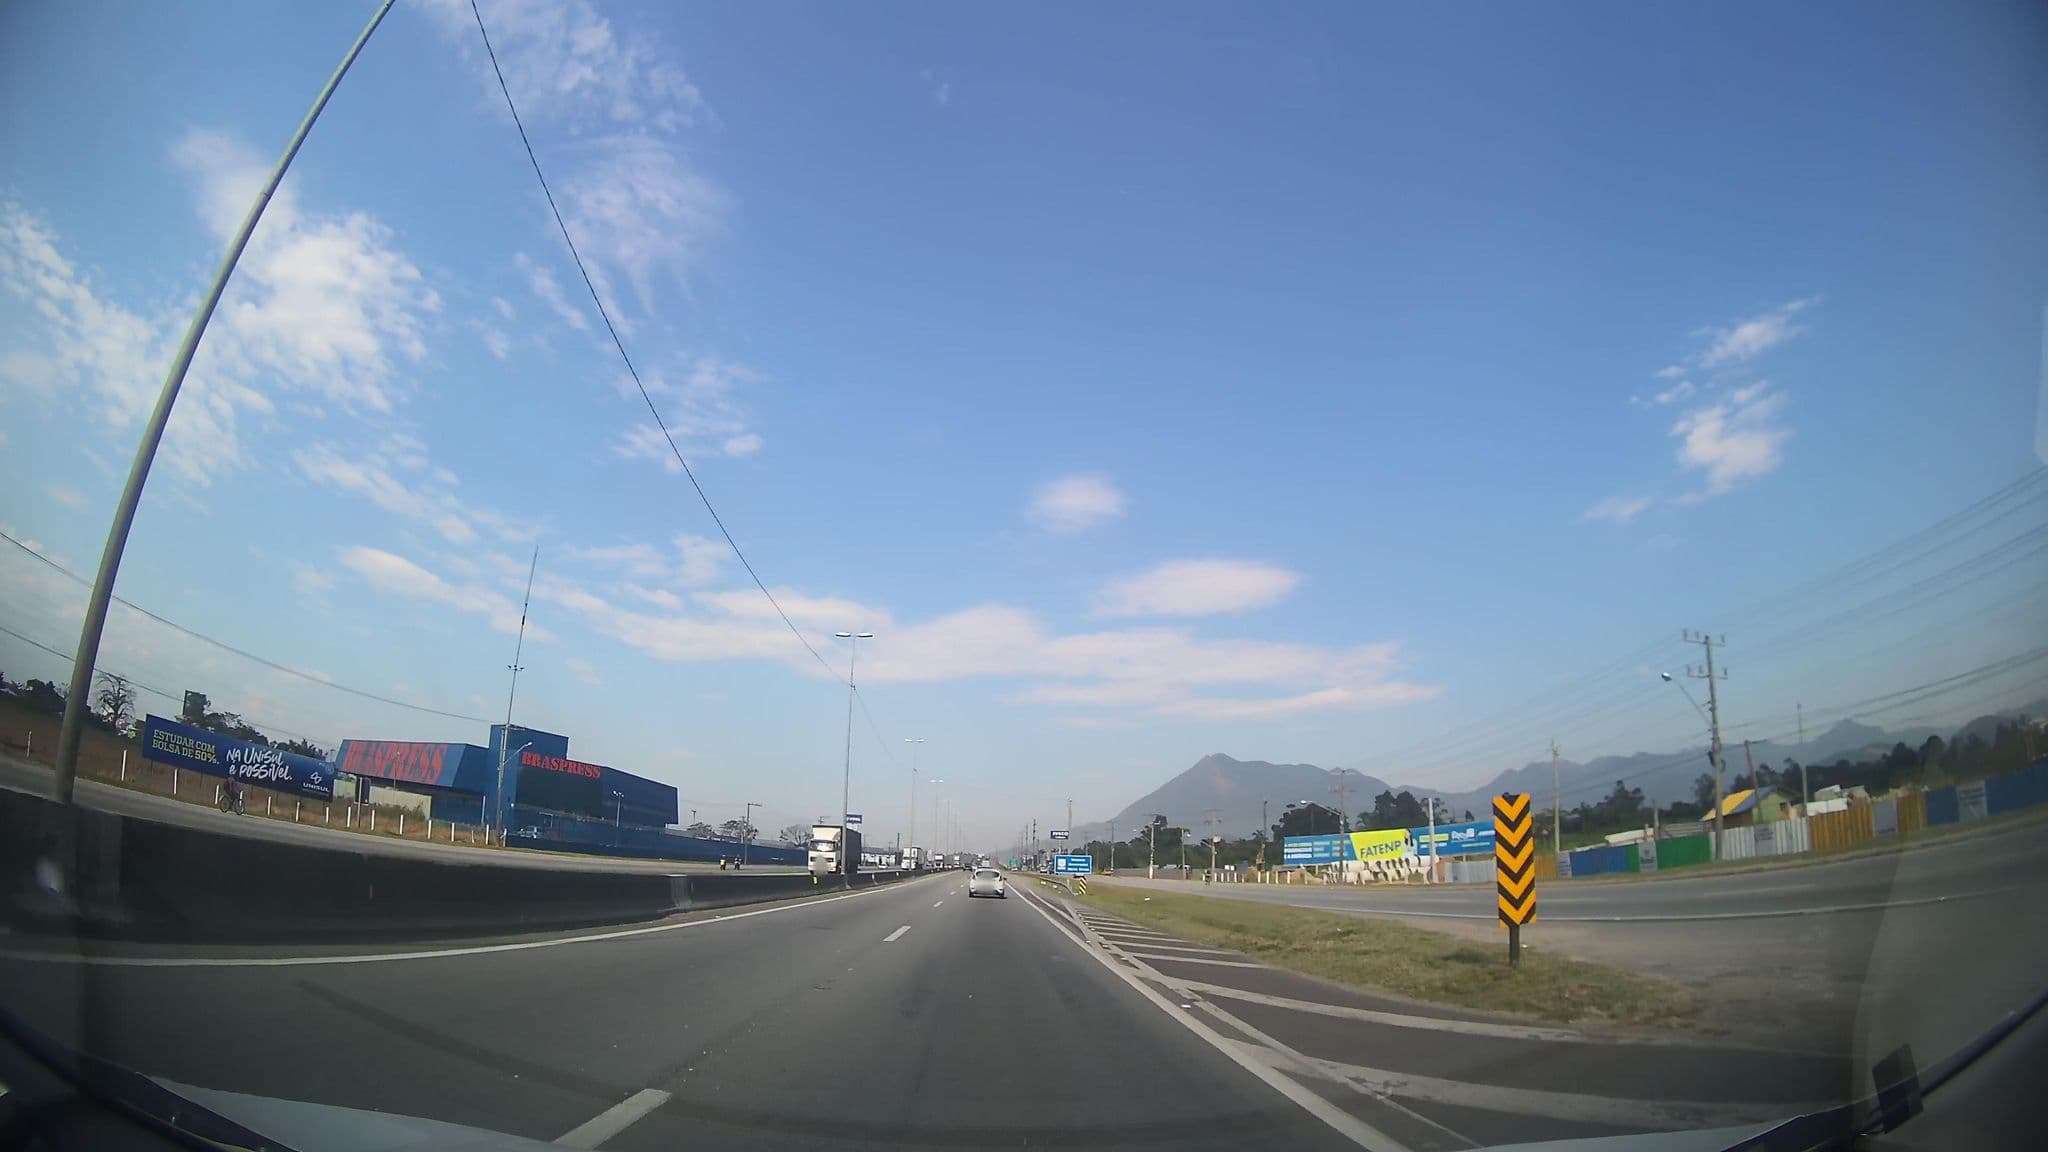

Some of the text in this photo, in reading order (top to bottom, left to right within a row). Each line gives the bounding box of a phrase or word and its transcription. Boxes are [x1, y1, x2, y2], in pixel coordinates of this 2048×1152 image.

[152, 739, 181, 755] BOLSA
[182, 747, 194, 758] DE
[153, 729, 216, 754] ESTUDAR COM
[226, 748, 241, 762] NA
[342, 741, 448, 785] BRASPRESS
[522, 752, 601, 778] BRASPRESS
[303, 782, 330, 793] UNISUL
[1360, 840, 1401, 859] FATENP
